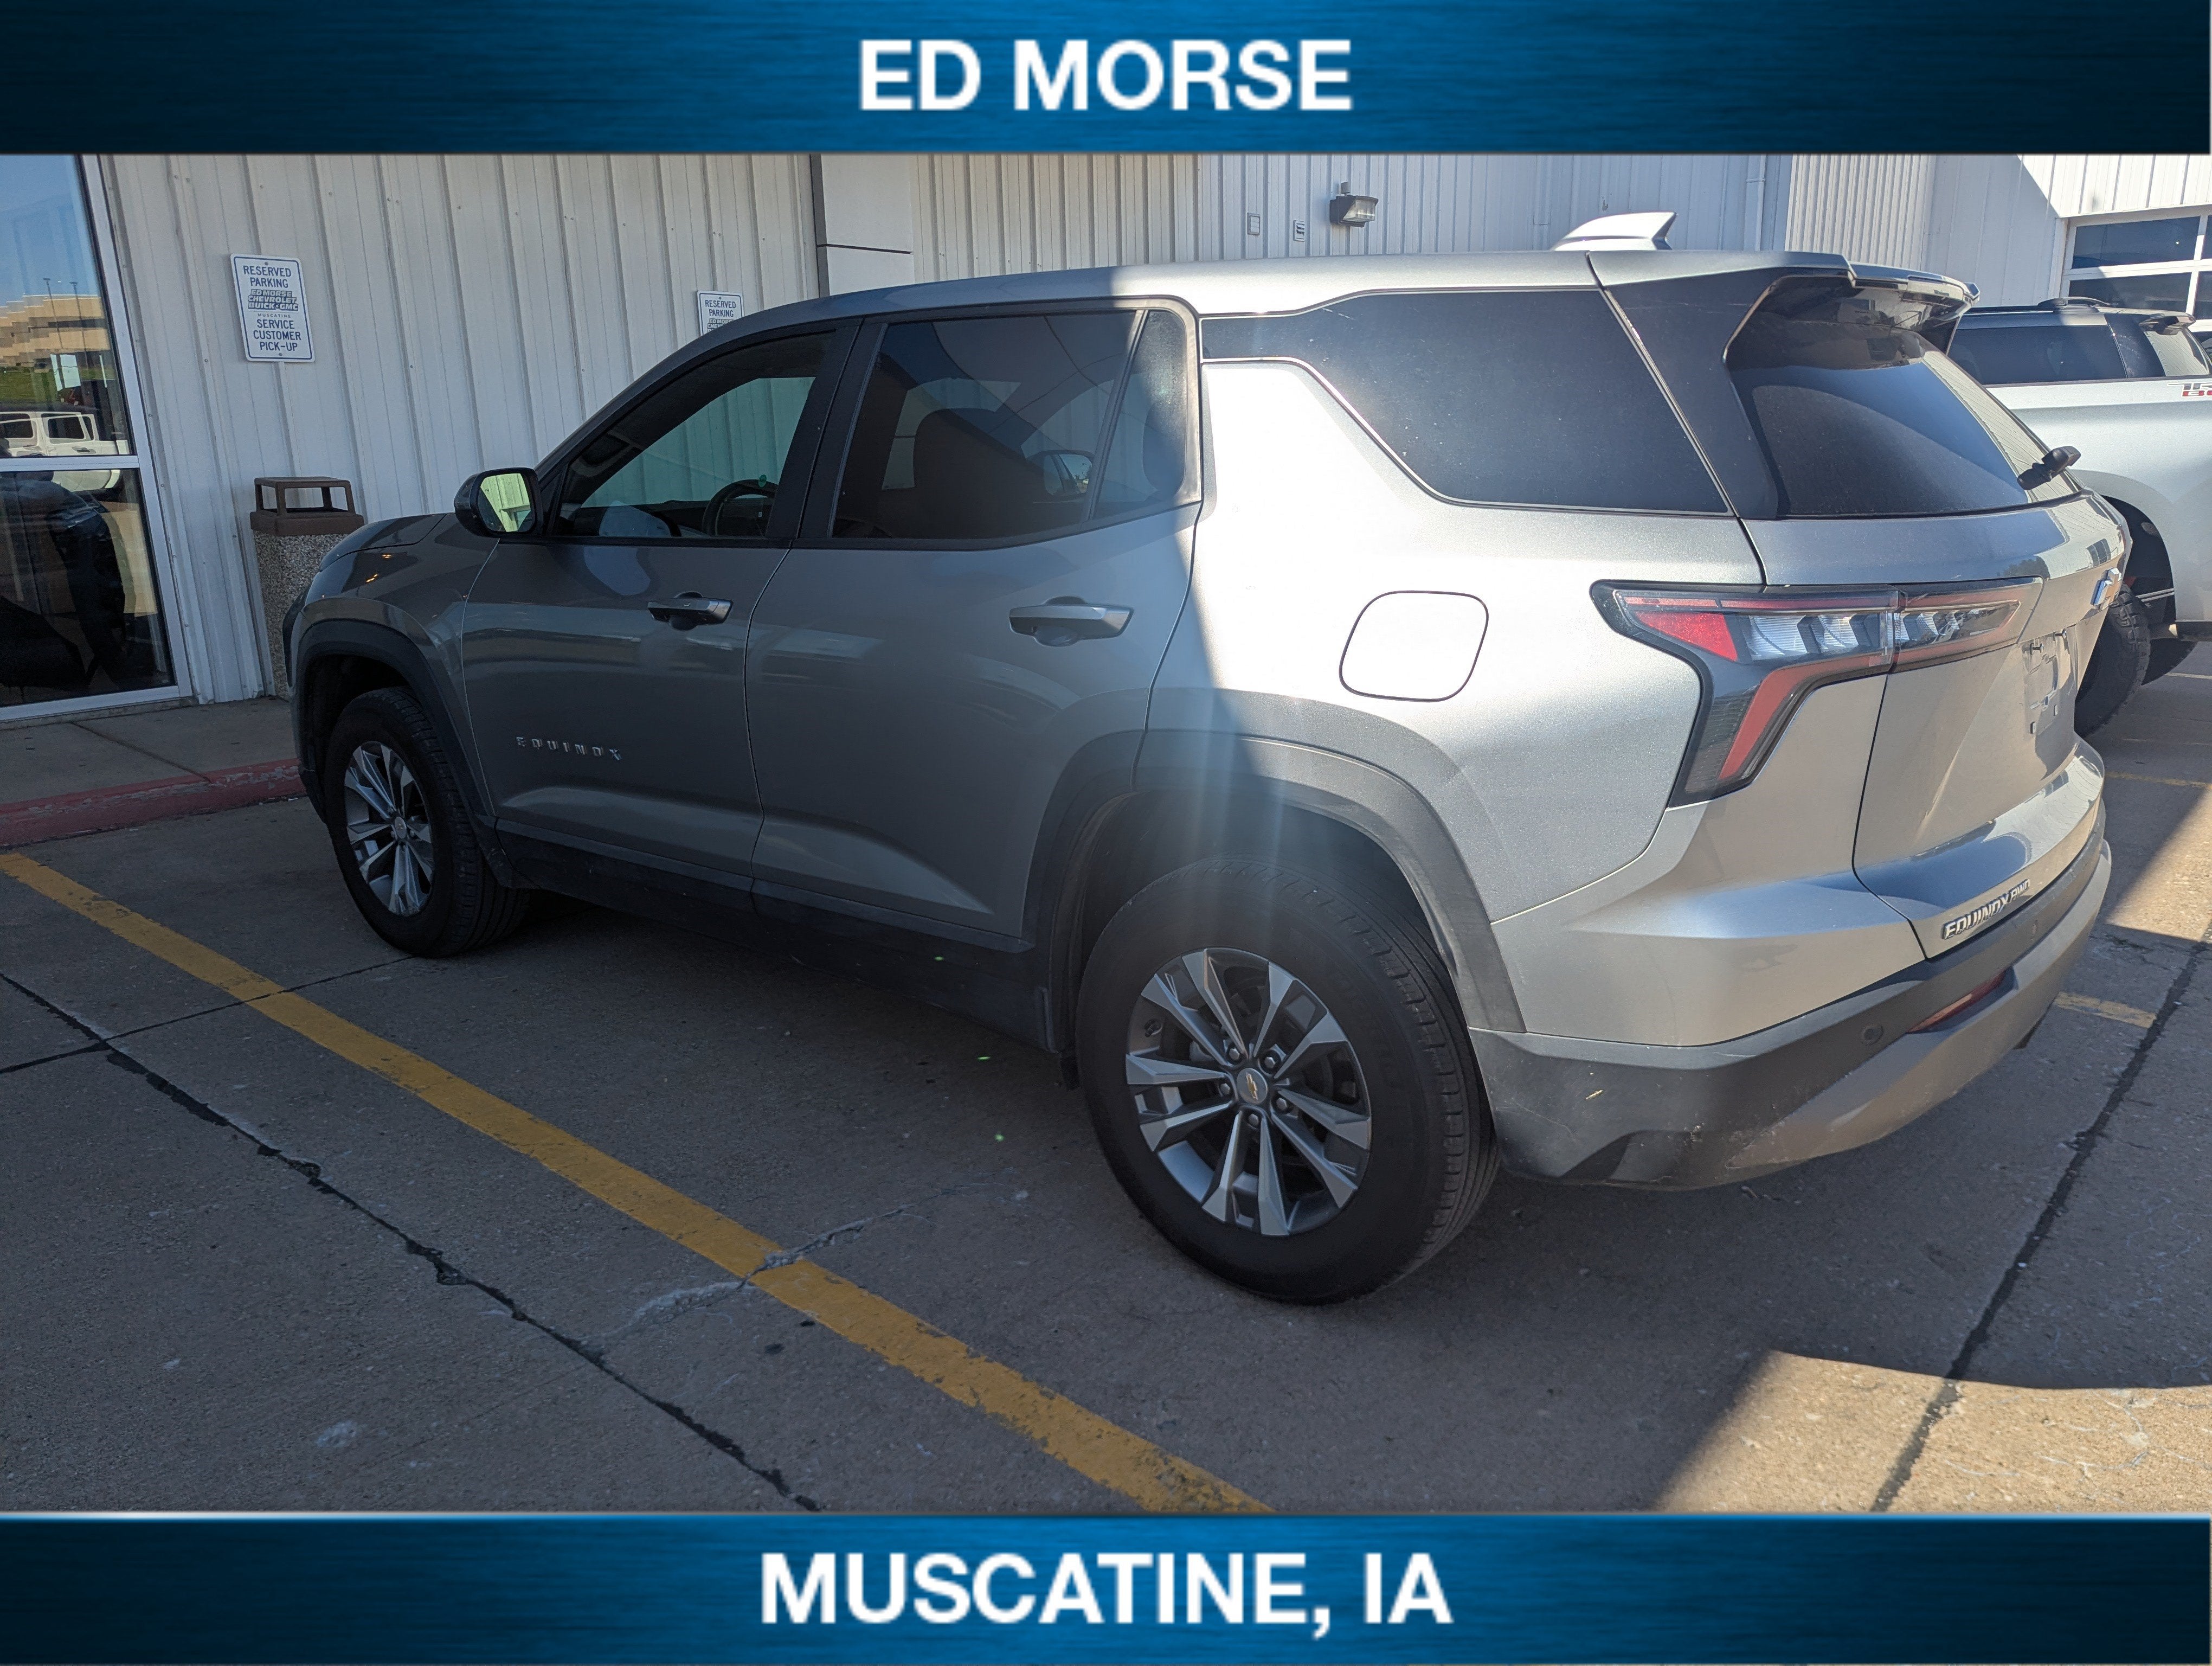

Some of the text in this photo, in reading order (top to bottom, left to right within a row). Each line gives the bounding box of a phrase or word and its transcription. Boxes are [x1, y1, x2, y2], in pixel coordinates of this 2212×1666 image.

[243, 266, 291, 277] RESERVED
[250, 277, 288, 288] PARKING
[705, 300, 736, 308] RESERVED
[709, 309, 734, 317] PARKING
[257, 320, 294, 329] SERVICE
[253, 330, 301, 340] CUSTOMER
[260, 342, 298, 351] PICK-UP
[516, 736, 622, 760] EQUINOX
[1944, 893, 2009, 940] EQUINOX
